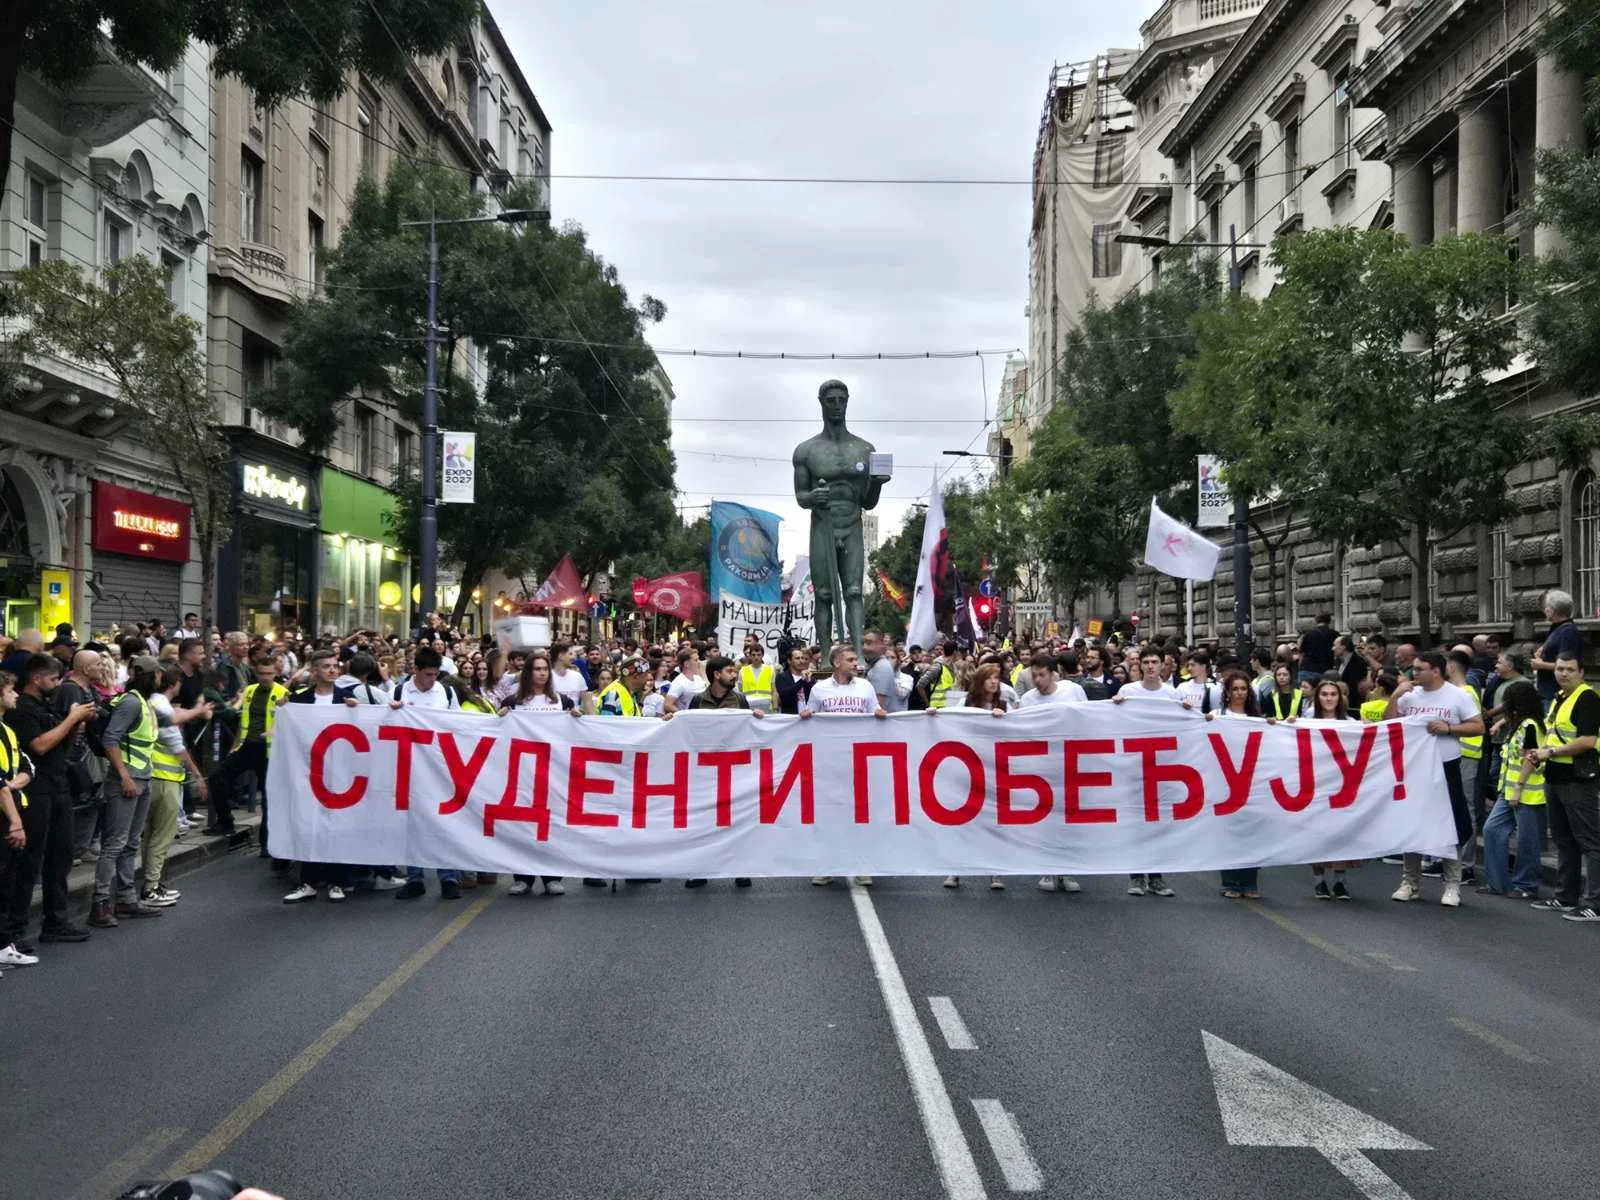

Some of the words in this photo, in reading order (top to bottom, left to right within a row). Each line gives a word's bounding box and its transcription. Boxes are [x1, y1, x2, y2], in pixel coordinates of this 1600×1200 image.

[445, 476, 472, 484] 2027
[310, 723, 815, 842] СТУДЕНТИ
[852, 722, 1405, 825] ПОБЕЂУЈУ!
